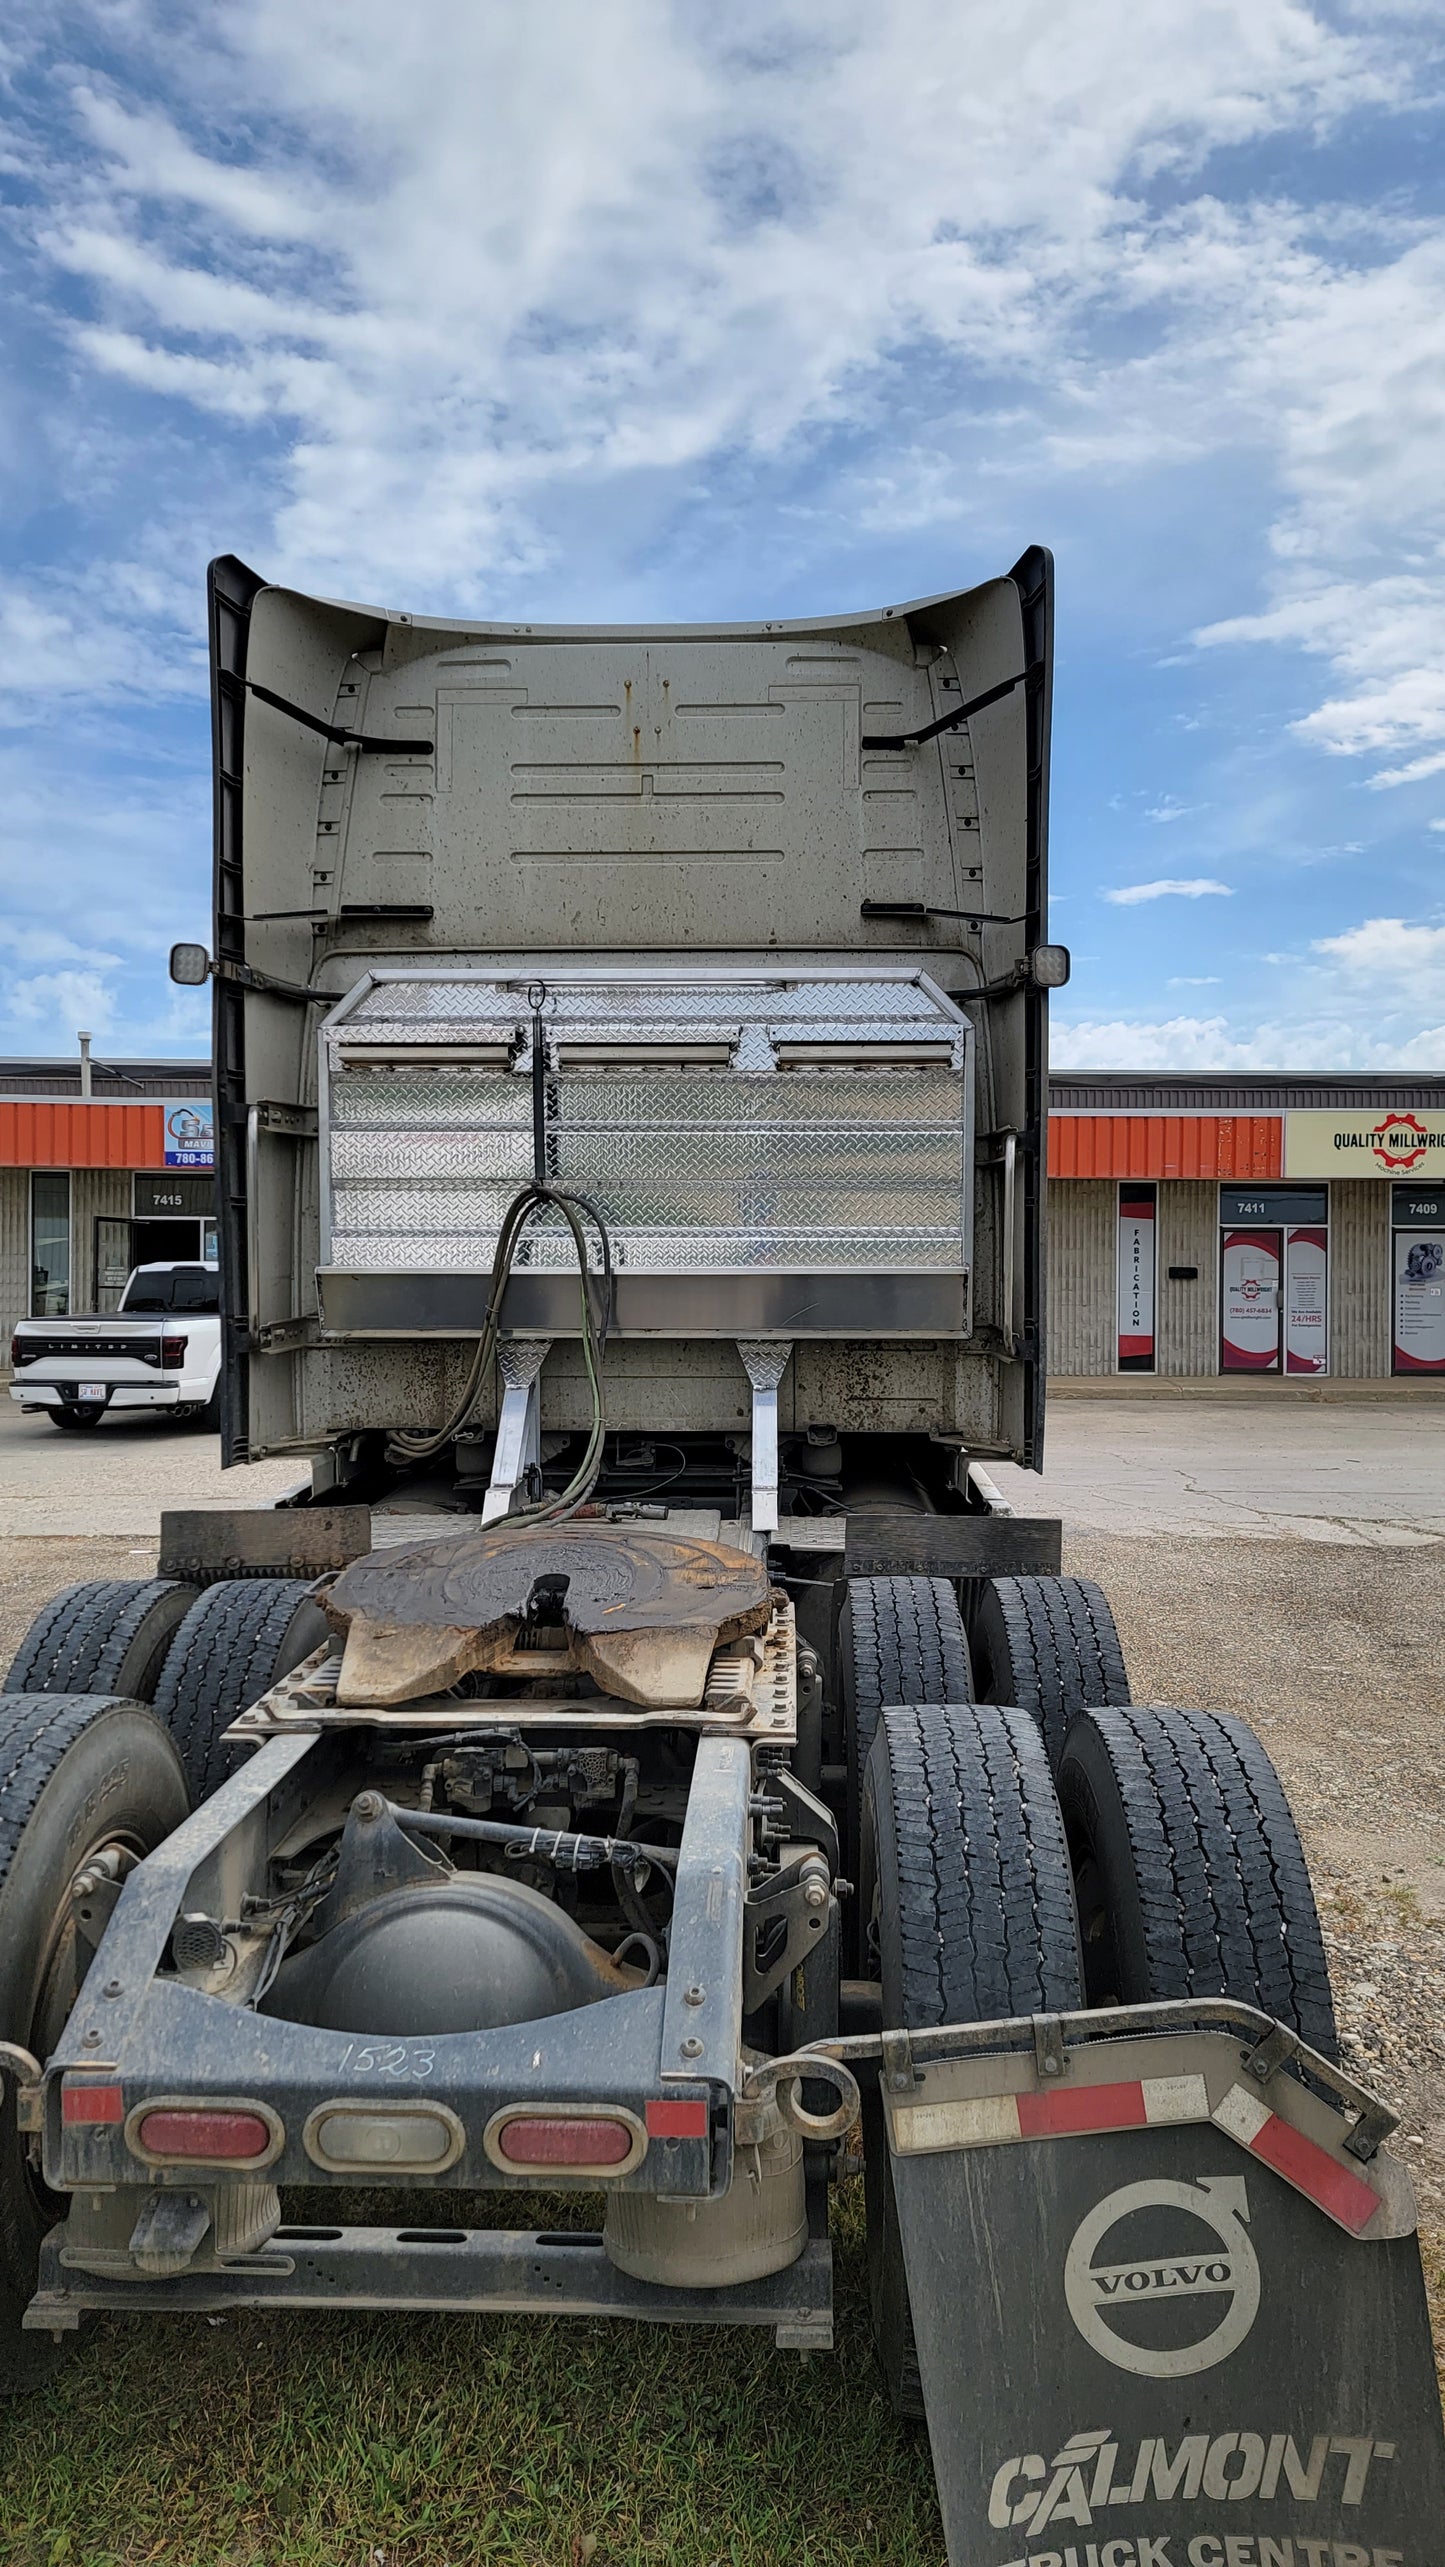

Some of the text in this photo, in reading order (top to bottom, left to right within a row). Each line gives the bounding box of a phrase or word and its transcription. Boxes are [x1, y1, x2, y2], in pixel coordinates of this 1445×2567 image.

[1333, 1133, 1385, 1150] QUALITY
[1375, 1161, 1425, 1176] Machine Services
[152, 1194, 183, 1206] 7415
[1237, 1202, 1265, 1214] 7411
[1408, 1203, 1438, 1215] 7409
[1132, 1229, 1141, 1327] FABRICATION
[1291, 1315, 1322, 1323] 24/HRS
[338, 2043, 436, 2079] 1523
[1091, 2263, 1231, 2294] VOLVO
[988, 2430, 1396, 2538] CALMONT
[998, 2536, 1175, 2567] UCK
